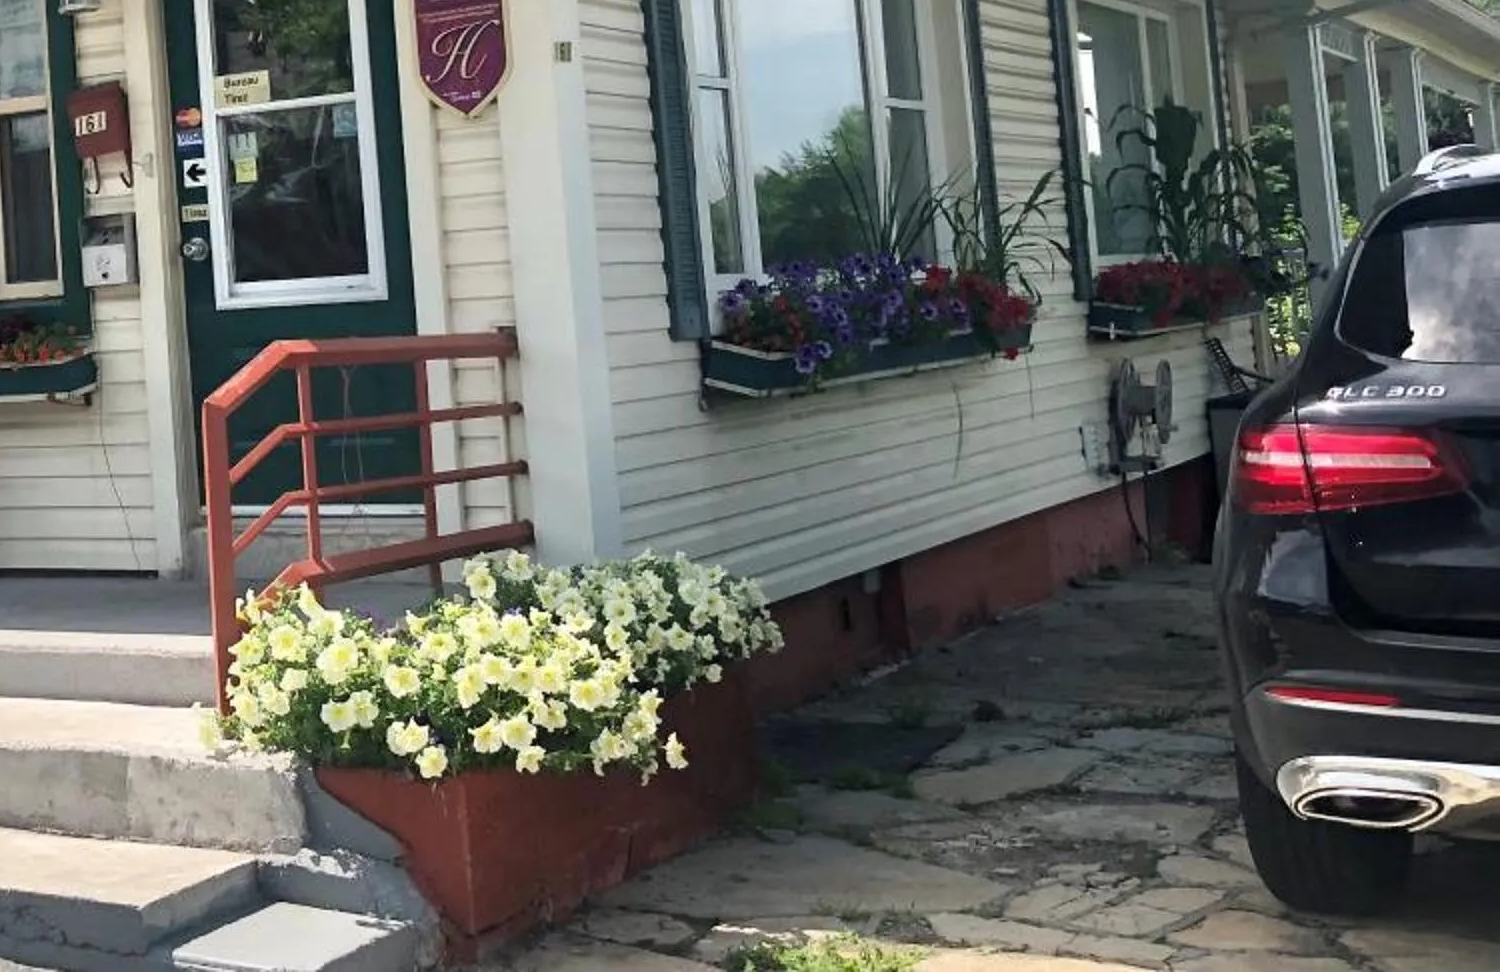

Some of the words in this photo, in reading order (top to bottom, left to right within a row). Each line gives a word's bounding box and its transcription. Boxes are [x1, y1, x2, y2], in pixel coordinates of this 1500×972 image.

[77, 113, 104, 135] 161
[1324, 385, 1379, 399] GLC
[1385, 385, 1446, 398] 300
